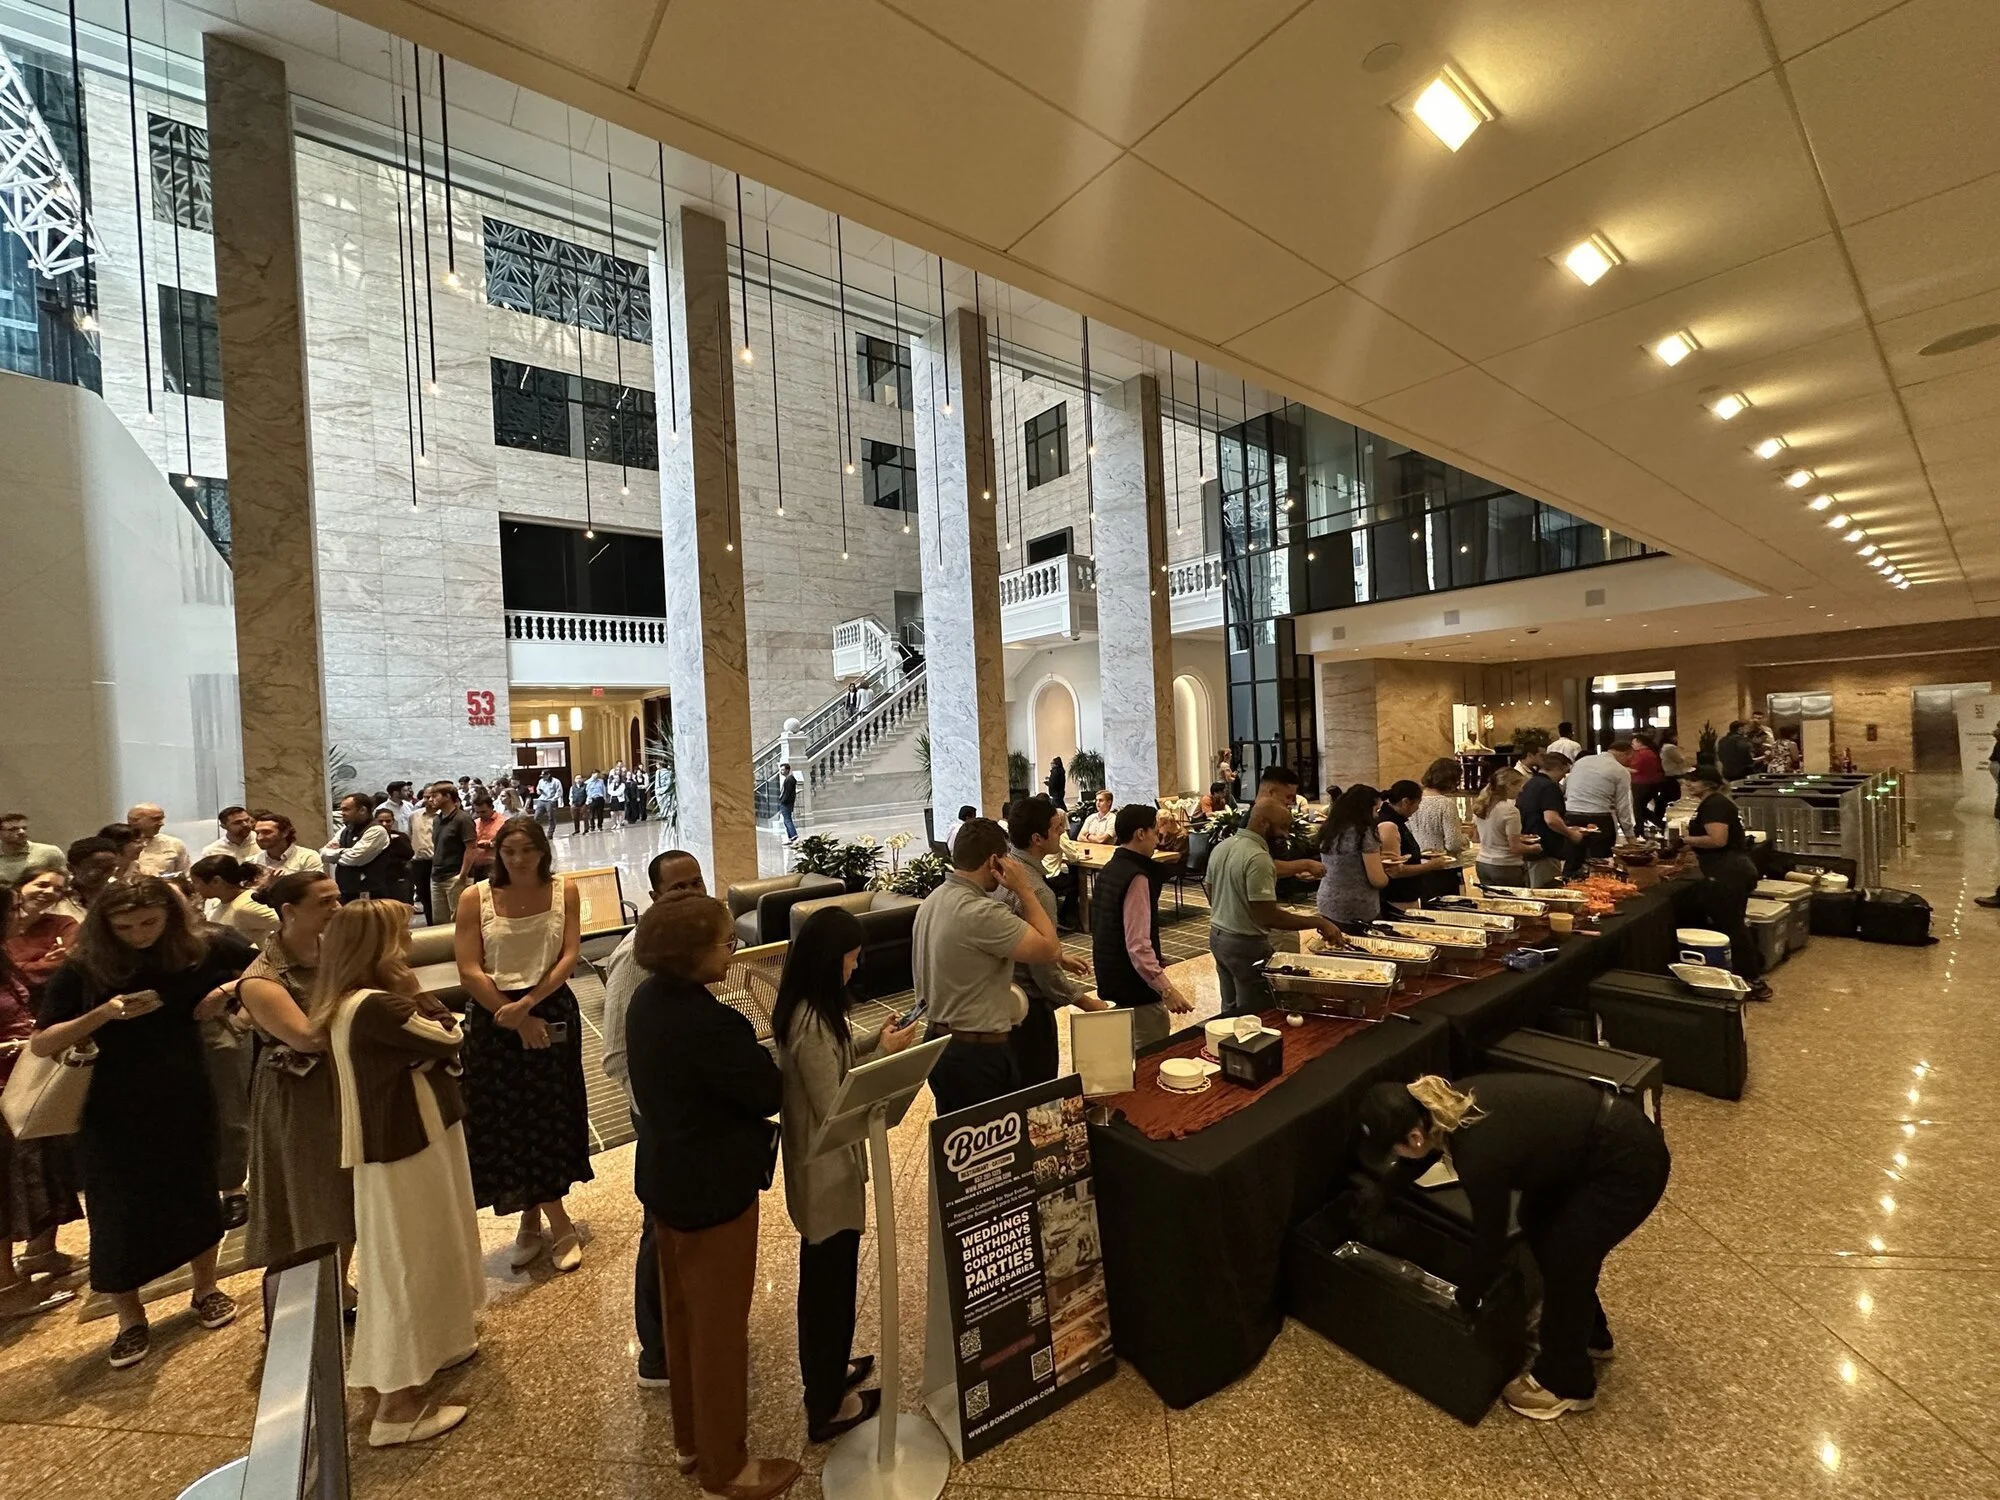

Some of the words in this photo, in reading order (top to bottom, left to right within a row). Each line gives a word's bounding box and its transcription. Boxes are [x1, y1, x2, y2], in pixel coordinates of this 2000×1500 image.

[467, 691, 496, 716] 53
[468, 715, 495, 726] STATE
[947, 1116, 1018, 1168] Bono
[961, 1163, 989, 1179] RESTAURANT
[961, 1211, 1029, 1249] WEDDINGS
[962, 1223, 1031, 1262] BIRTHDAYS
[964, 1235, 1033, 1273] CORPORATE
[965, 1246, 1034, 1290] PARTIES
[968, 1261, 1035, 1300] ANNIVERSARIES
[968, 1385, 1056, 1439] WWW.BONOBOSTON.COM
